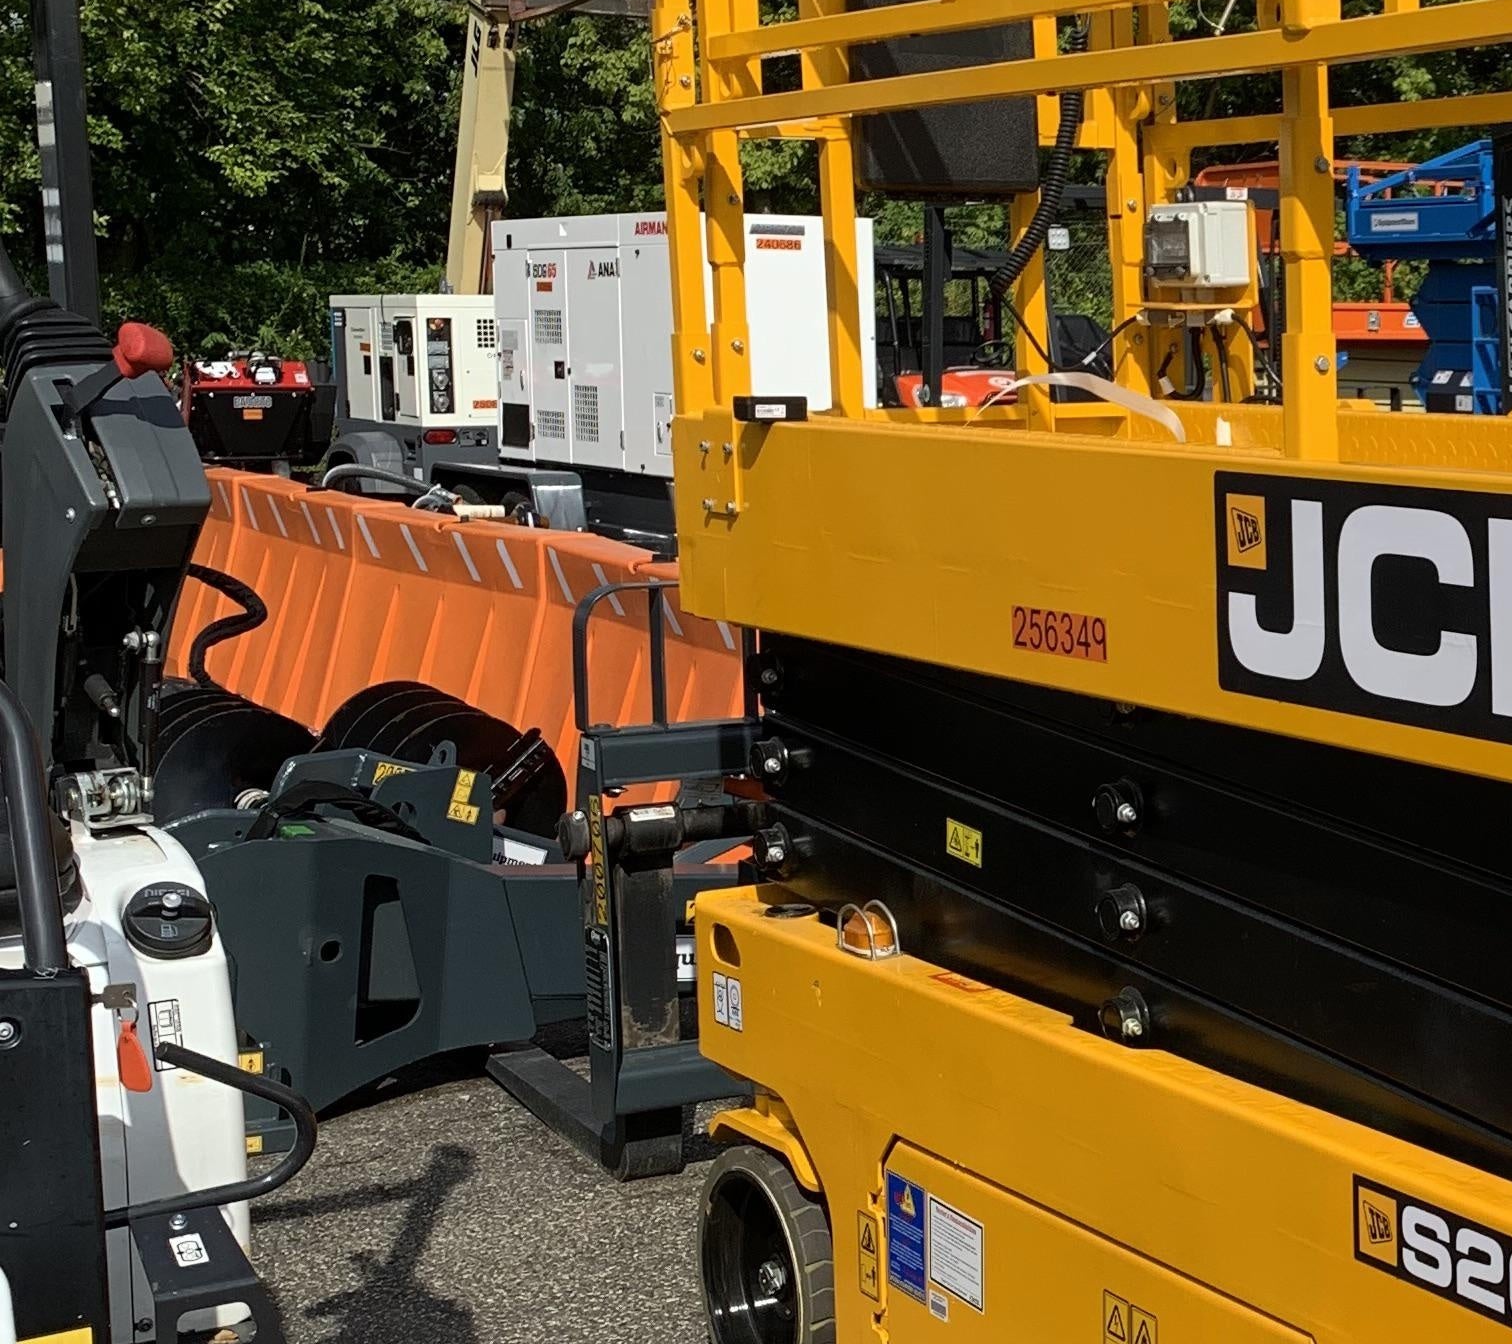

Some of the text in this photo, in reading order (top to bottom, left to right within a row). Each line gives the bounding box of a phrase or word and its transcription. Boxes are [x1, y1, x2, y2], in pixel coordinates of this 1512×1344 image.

[470, 19, 482, 78] JLG
[1236, 511, 1261, 547] JCB
[1013, 605, 1107, 661] 256349
[1368, 1207, 1391, 1240] JCB
